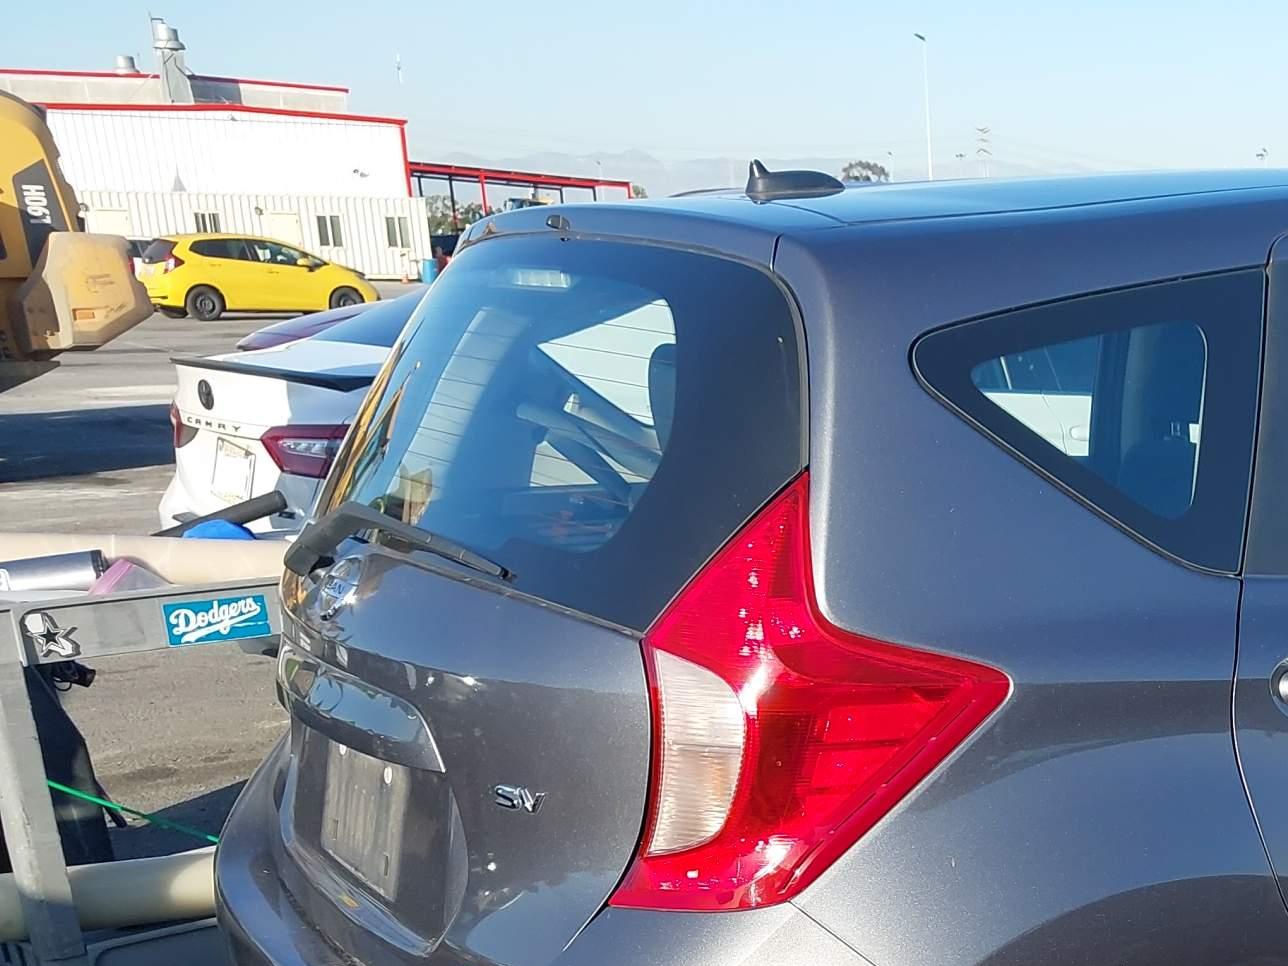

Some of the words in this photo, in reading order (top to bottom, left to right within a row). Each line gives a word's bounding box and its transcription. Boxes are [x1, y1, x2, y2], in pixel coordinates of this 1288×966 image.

[21, 184, 52, 225] L90H
[187, 416, 241, 432] CAMRY
[169, 597, 260, 638] Dodgers
[494, 785, 547, 815] SV
